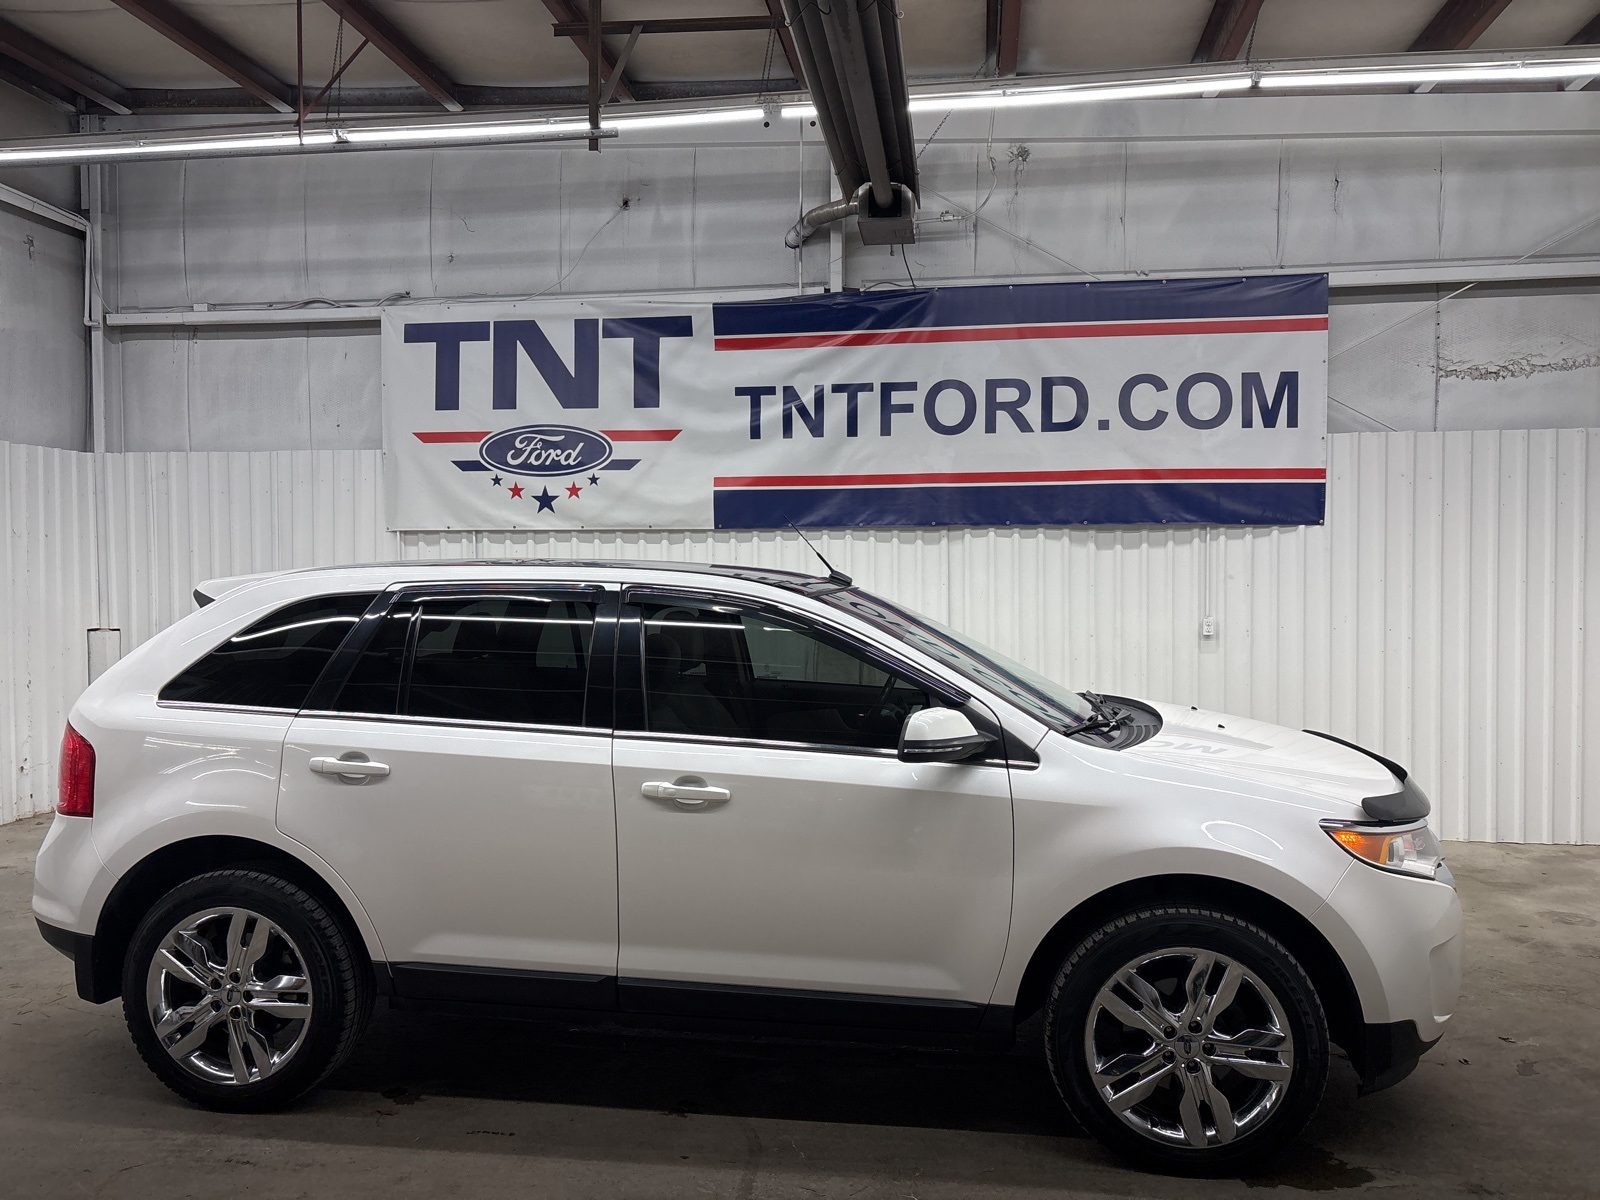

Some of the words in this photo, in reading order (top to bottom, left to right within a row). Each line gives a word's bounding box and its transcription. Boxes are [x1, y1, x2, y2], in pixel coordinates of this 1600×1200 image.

[404, 315, 694, 411] TNT
[734, 371, 1300, 441] TNTFORD.COM
[506, 433, 585, 466] Ford
